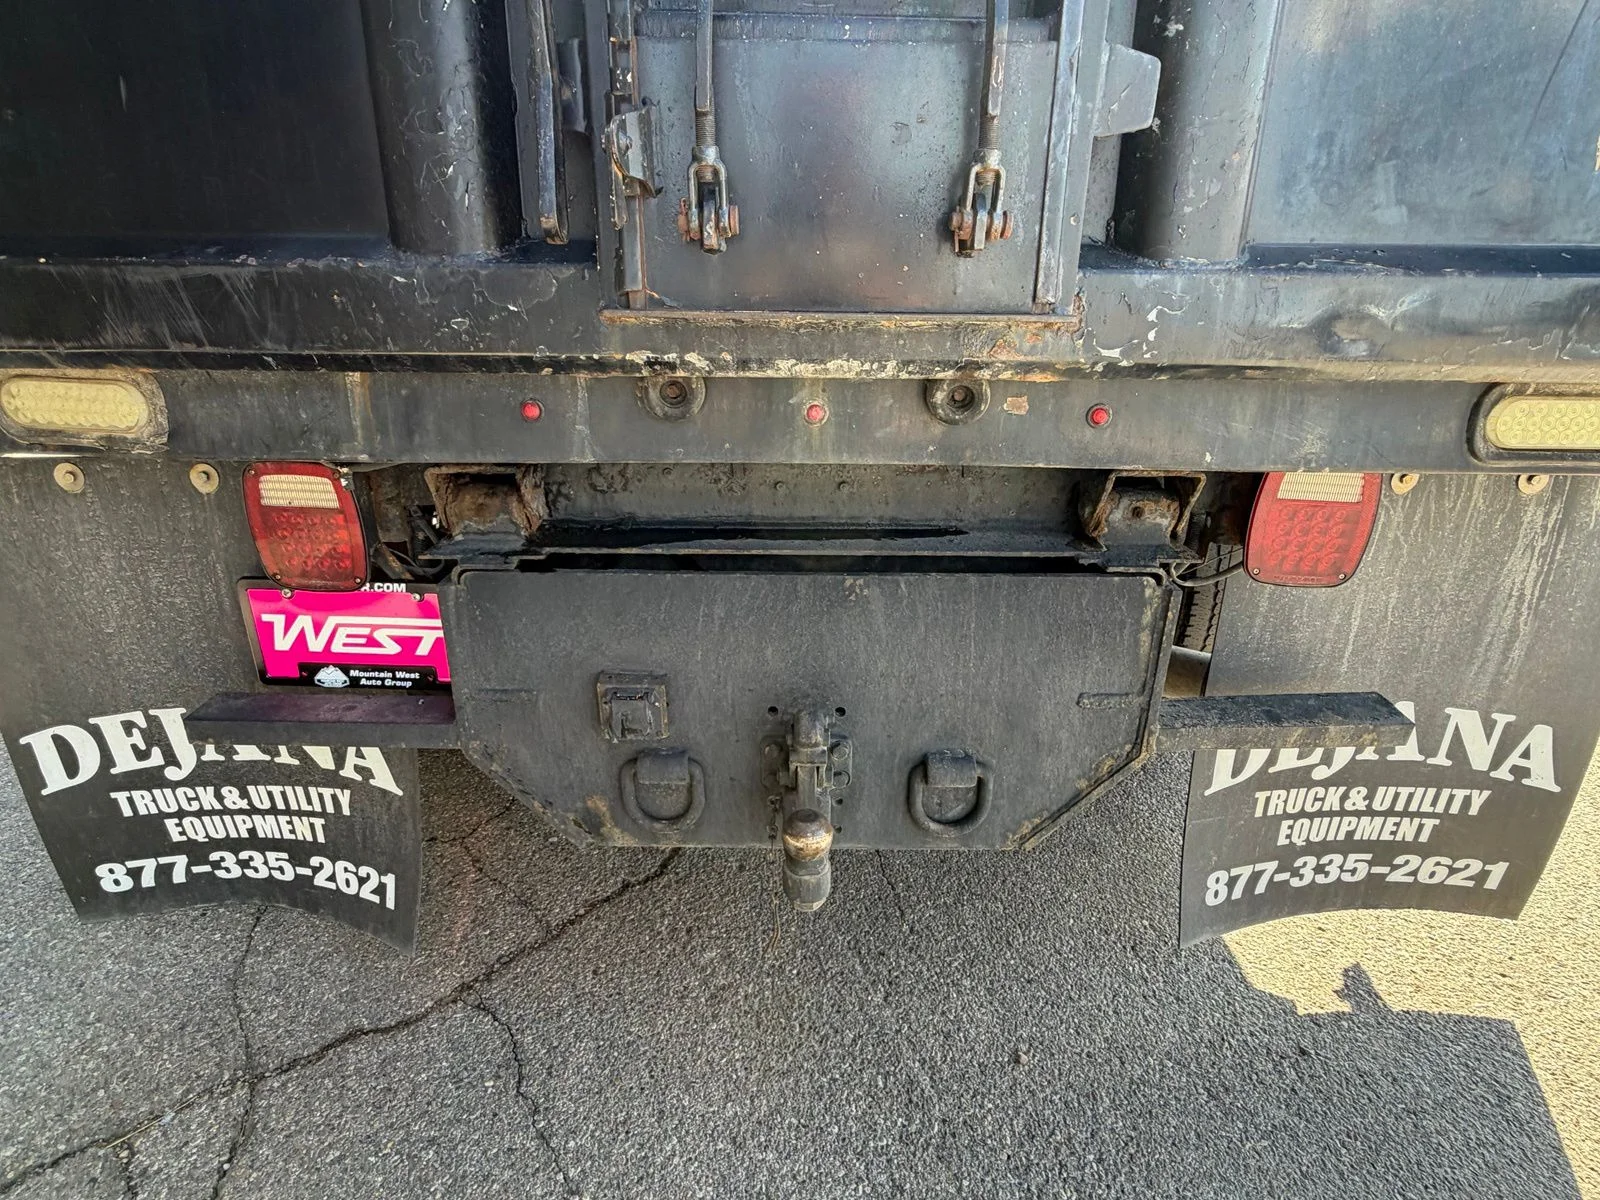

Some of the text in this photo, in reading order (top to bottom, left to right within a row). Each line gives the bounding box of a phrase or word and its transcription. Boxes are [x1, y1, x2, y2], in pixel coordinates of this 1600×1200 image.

[261, 613, 445, 656] WEST
[349, 669, 420, 679] Mountain West
[359, 678, 412, 689] Auto Group
[19, 707, 404, 797] DEJA
[163, 814, 326, 844] EQUIPMENT
[1276, 816, 1441, 847] EQUIPMENT
[94, 850, 396, 910] 877-335-2621
[1204, 853, 1510, 907] 877-335-2621
